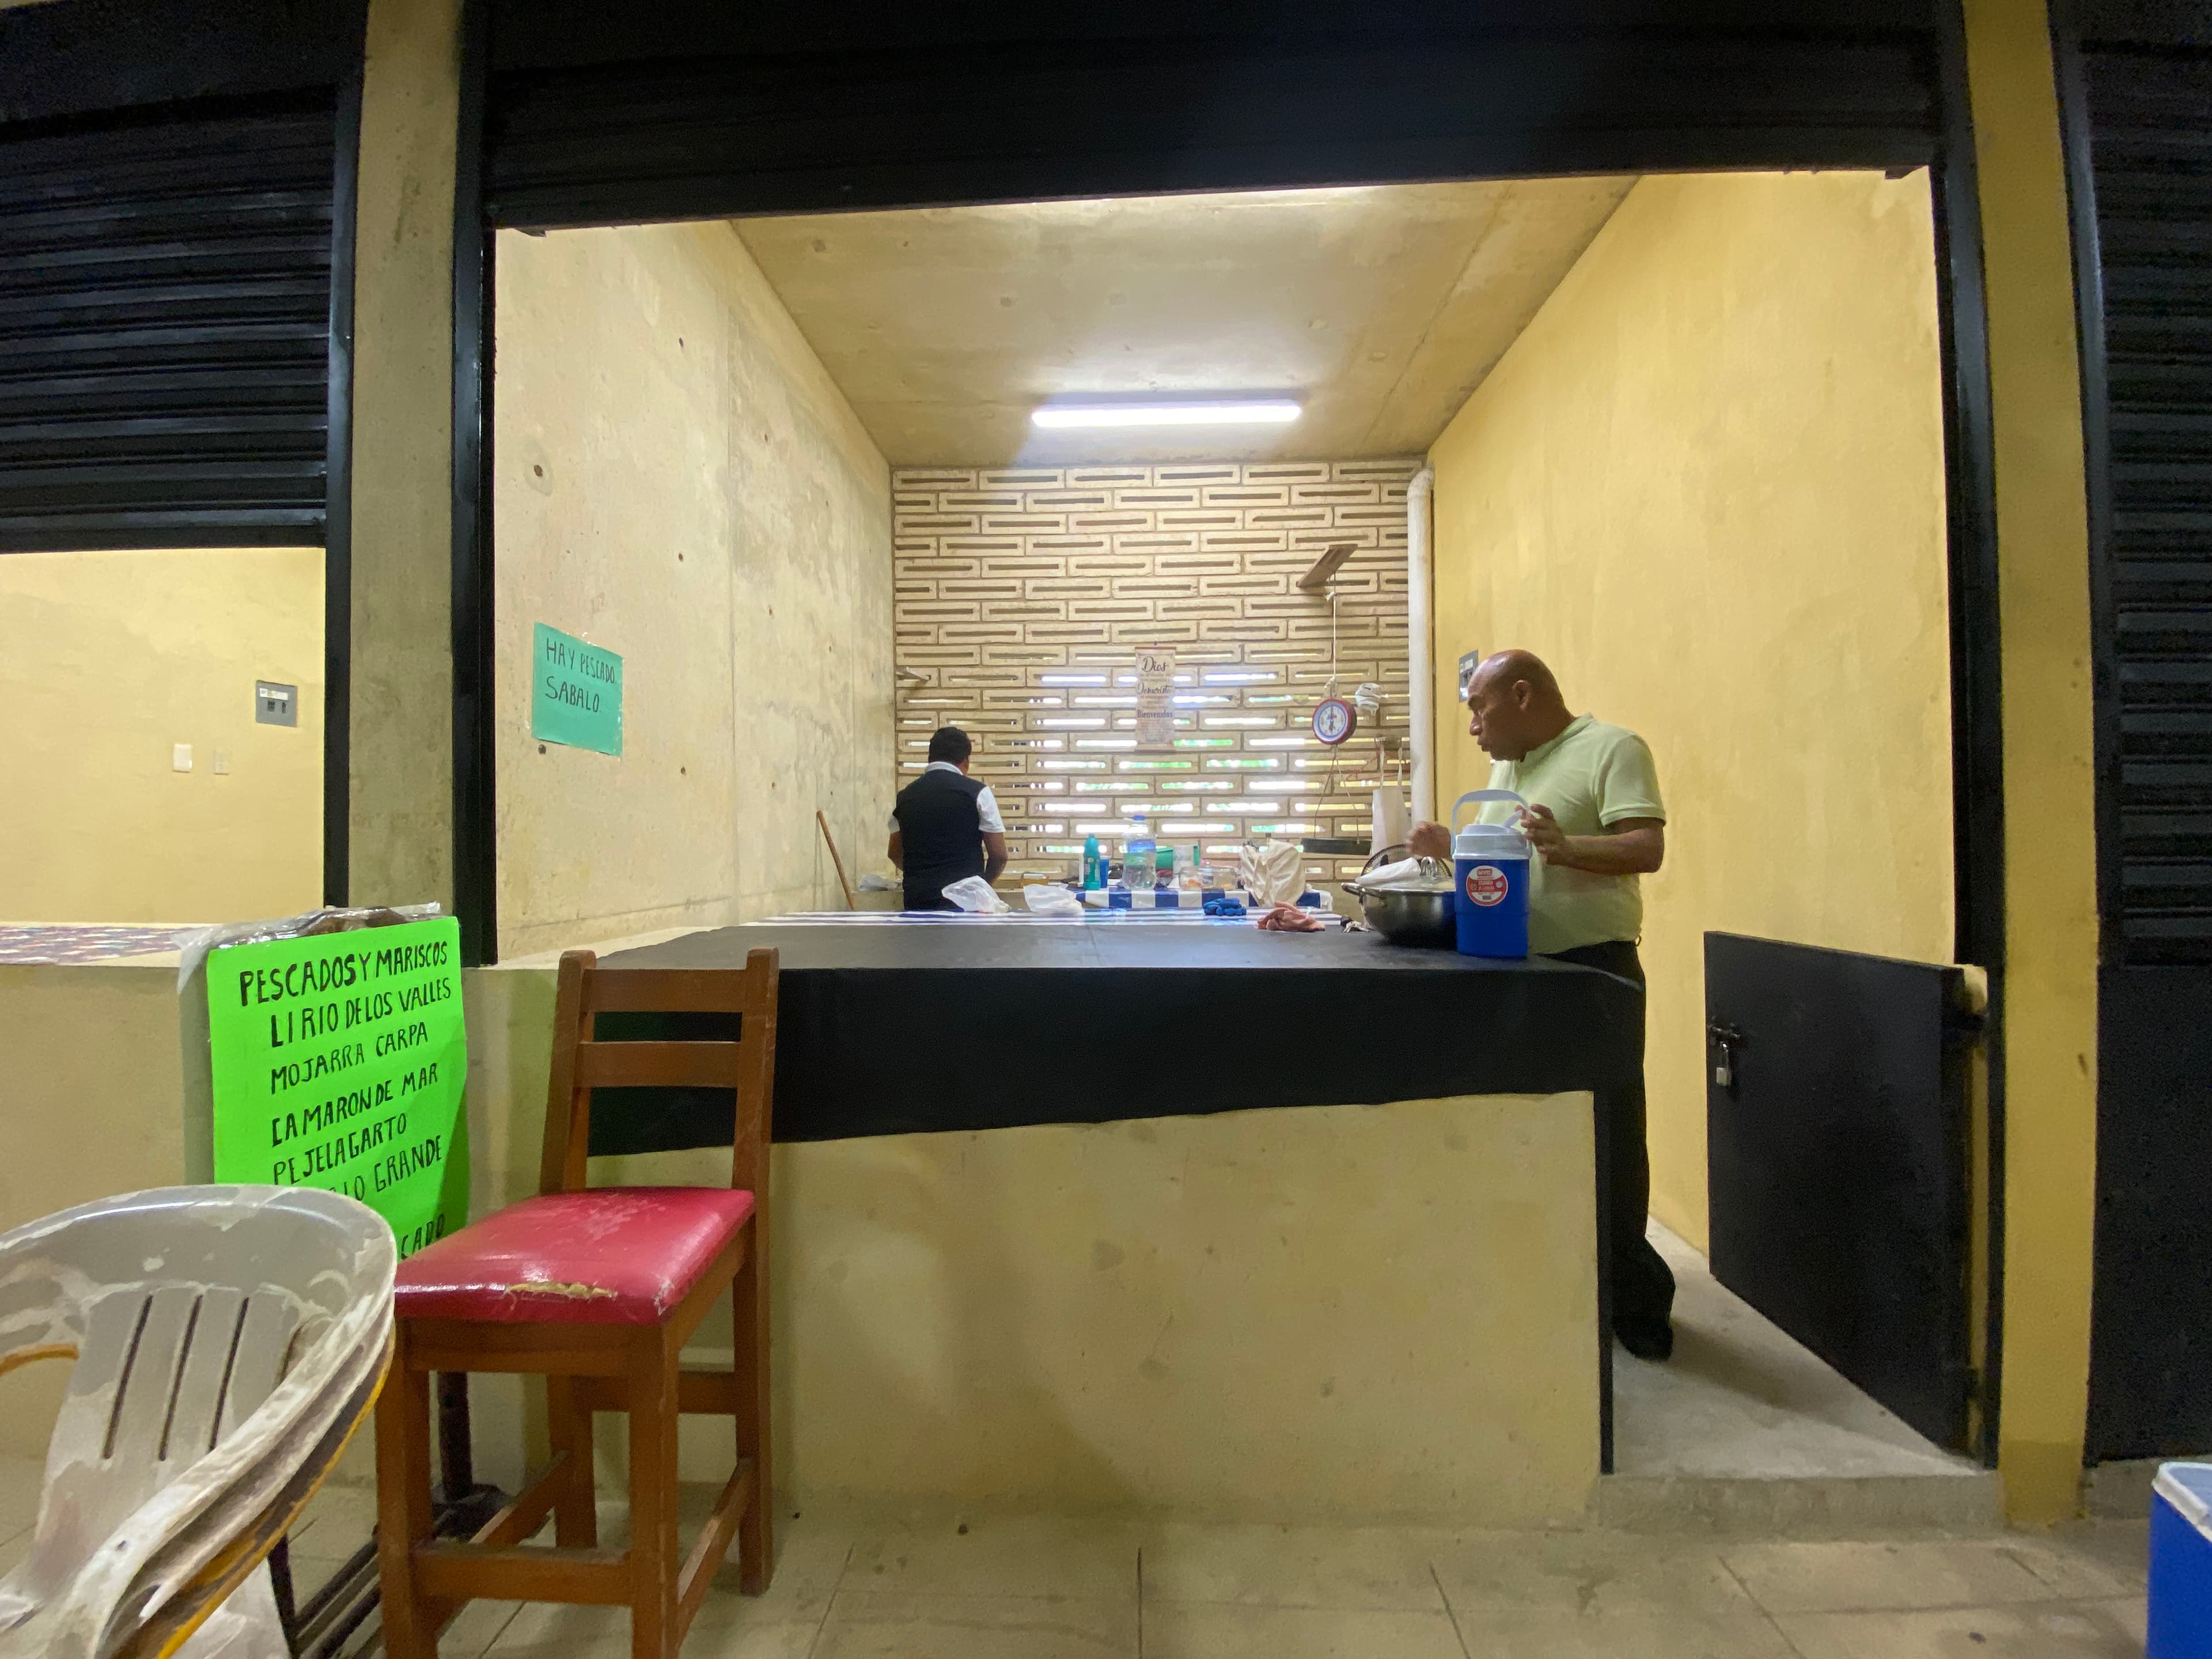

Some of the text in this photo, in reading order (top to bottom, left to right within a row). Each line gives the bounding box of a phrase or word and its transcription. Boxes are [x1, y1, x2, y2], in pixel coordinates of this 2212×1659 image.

[546, 637, 575, 670] HAY
[1142, 656, 1169, 672] Dios
[1137, 709, 1173, 718] Bienvenidos
[375, 941, 448, 978] MARISCOS
[398, 977, 451, 1012] VALLES
[271, 1021, 429, 1095] MOJARRA CARPA
[402, 1062, 438, 1097] MAR
[373, 1135, 443, 1193] GRANDE
[400, 1214, 446, 1260] CADO
